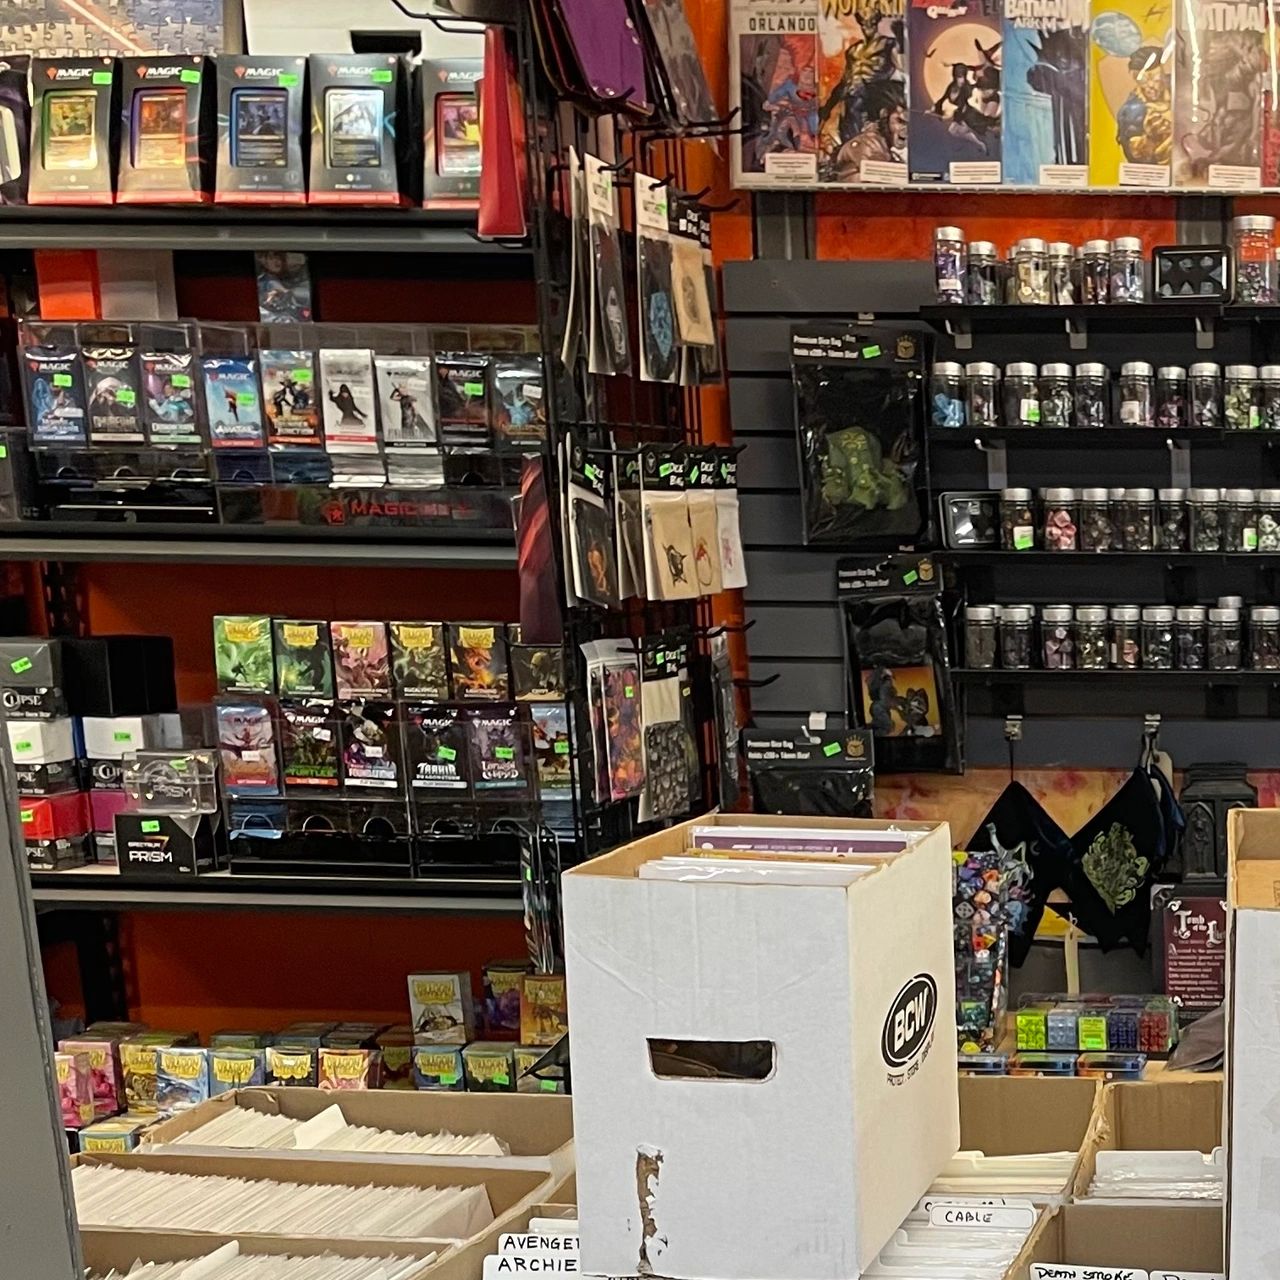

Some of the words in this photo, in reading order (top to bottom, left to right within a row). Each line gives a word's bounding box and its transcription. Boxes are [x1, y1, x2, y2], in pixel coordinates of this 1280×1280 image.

[749, 17, 816, 31] ORLANDO
[129, 851, 173, 863] PRISM
[894, 986, 929, 1053] BCW
[945, 1210, 993, 1224] CABLE
[498, 1257, 577, 1272] ARCHIE
[1034, 1267, 1077, 1280] DEATH
